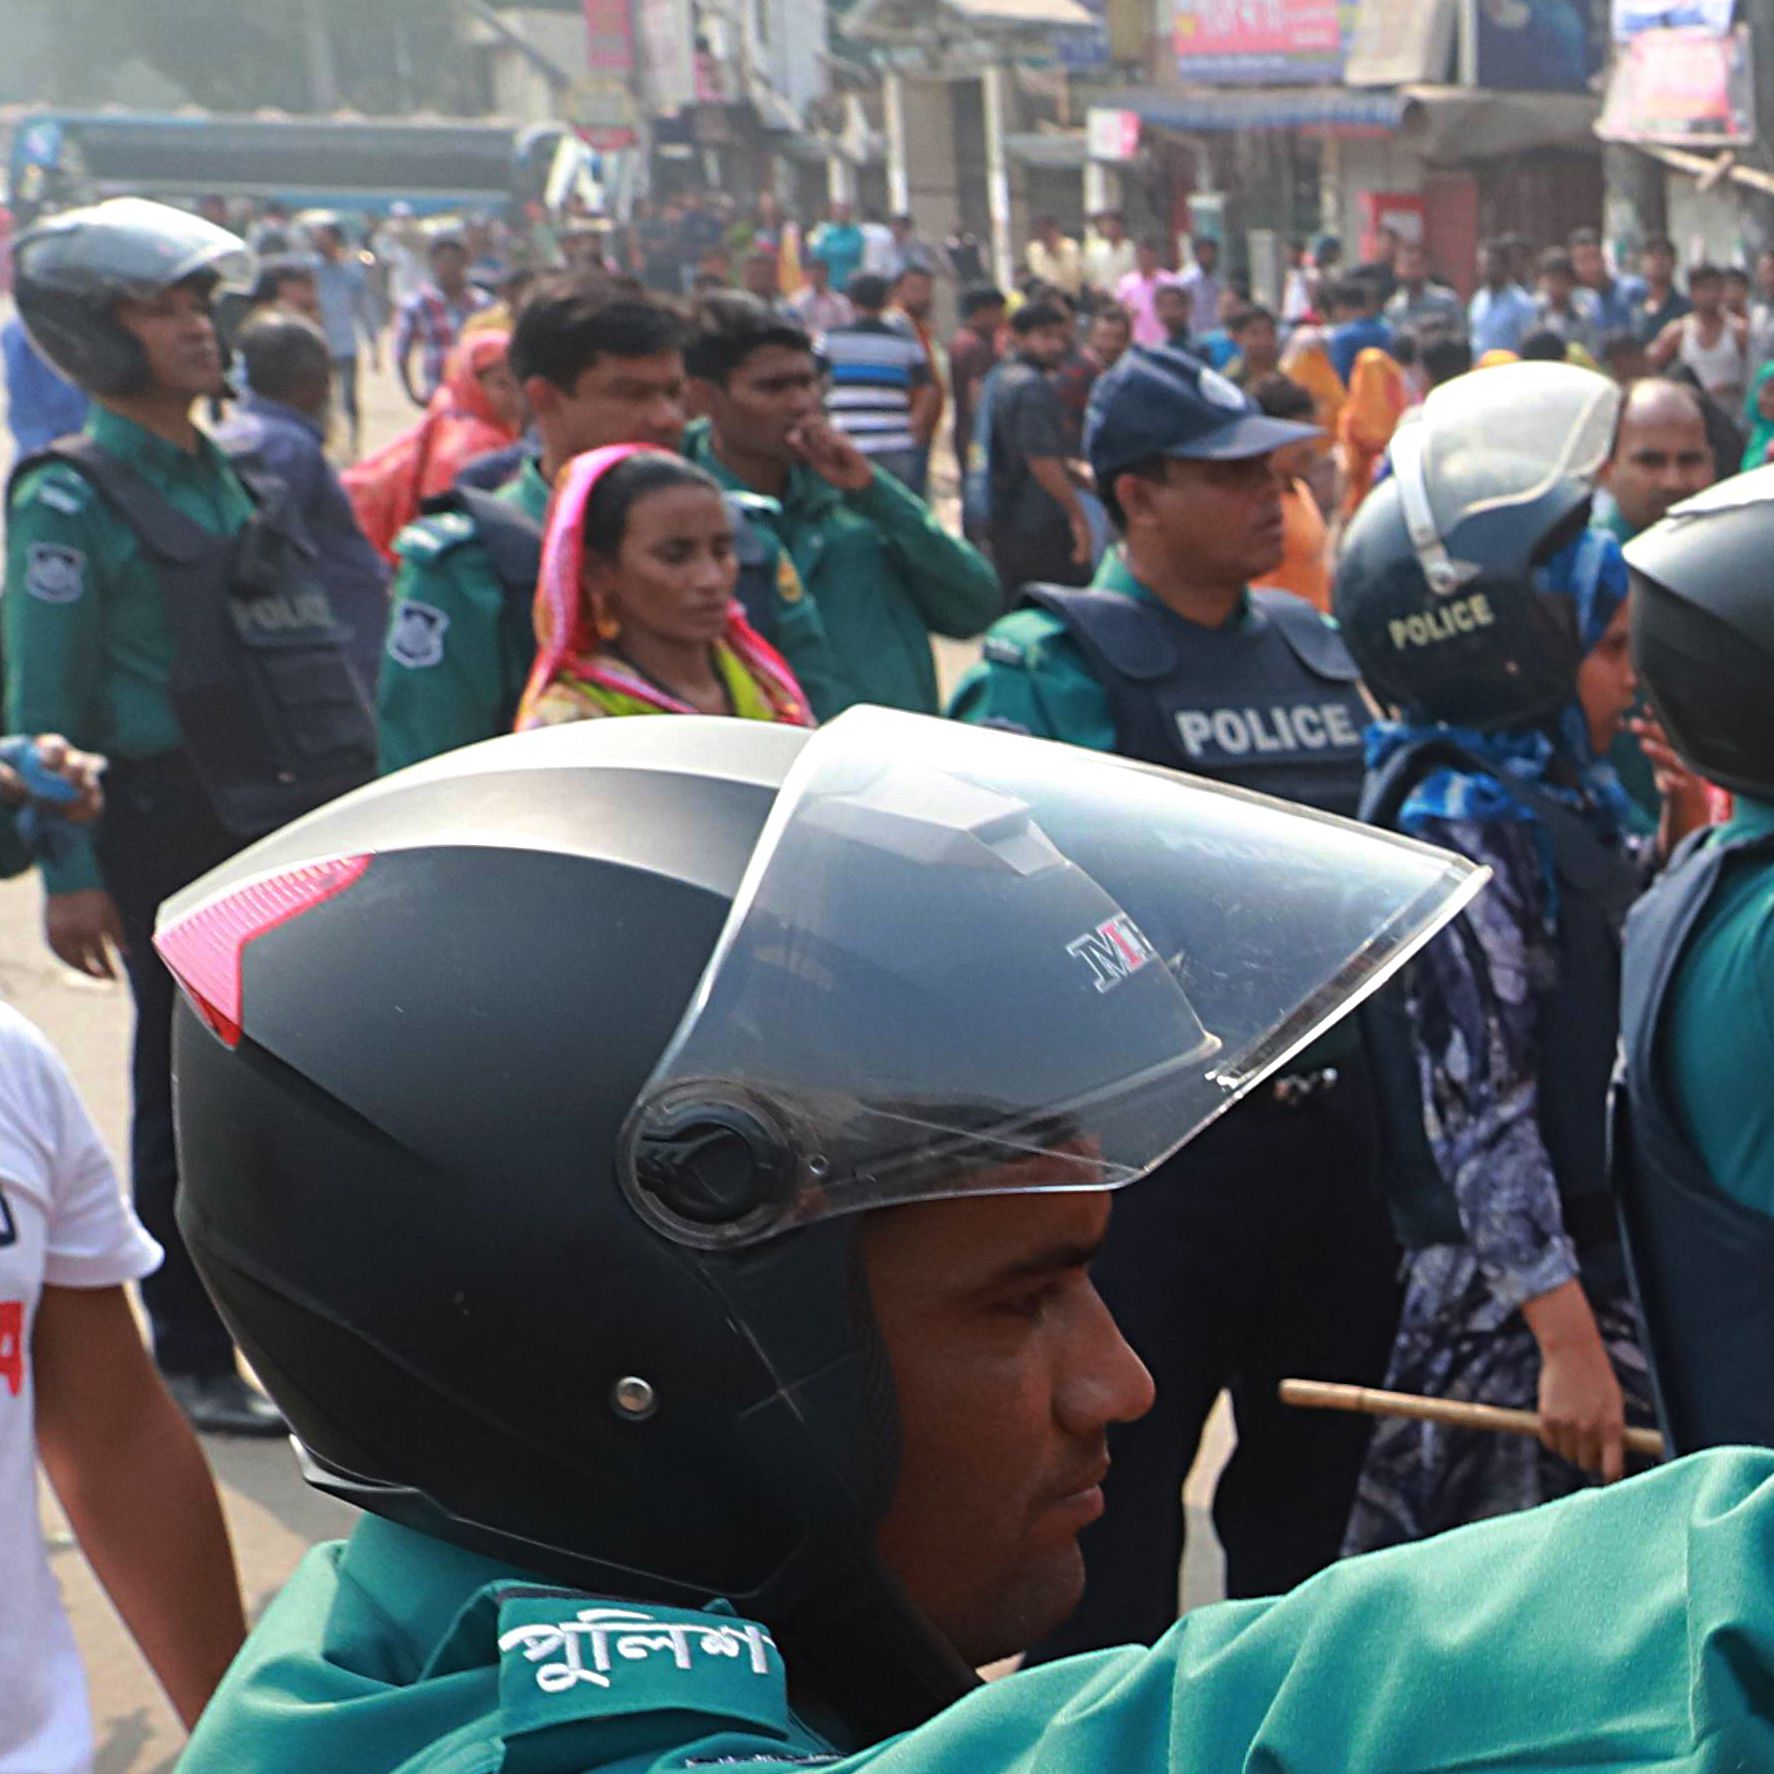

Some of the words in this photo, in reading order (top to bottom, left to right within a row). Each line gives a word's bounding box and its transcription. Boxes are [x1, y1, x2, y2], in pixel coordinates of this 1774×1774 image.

[1387, 592, 1495, 651] POLICE
[1174, 703, 1361, 757] POLICE
[497, 1608, 776, 1693] পুলিশ
